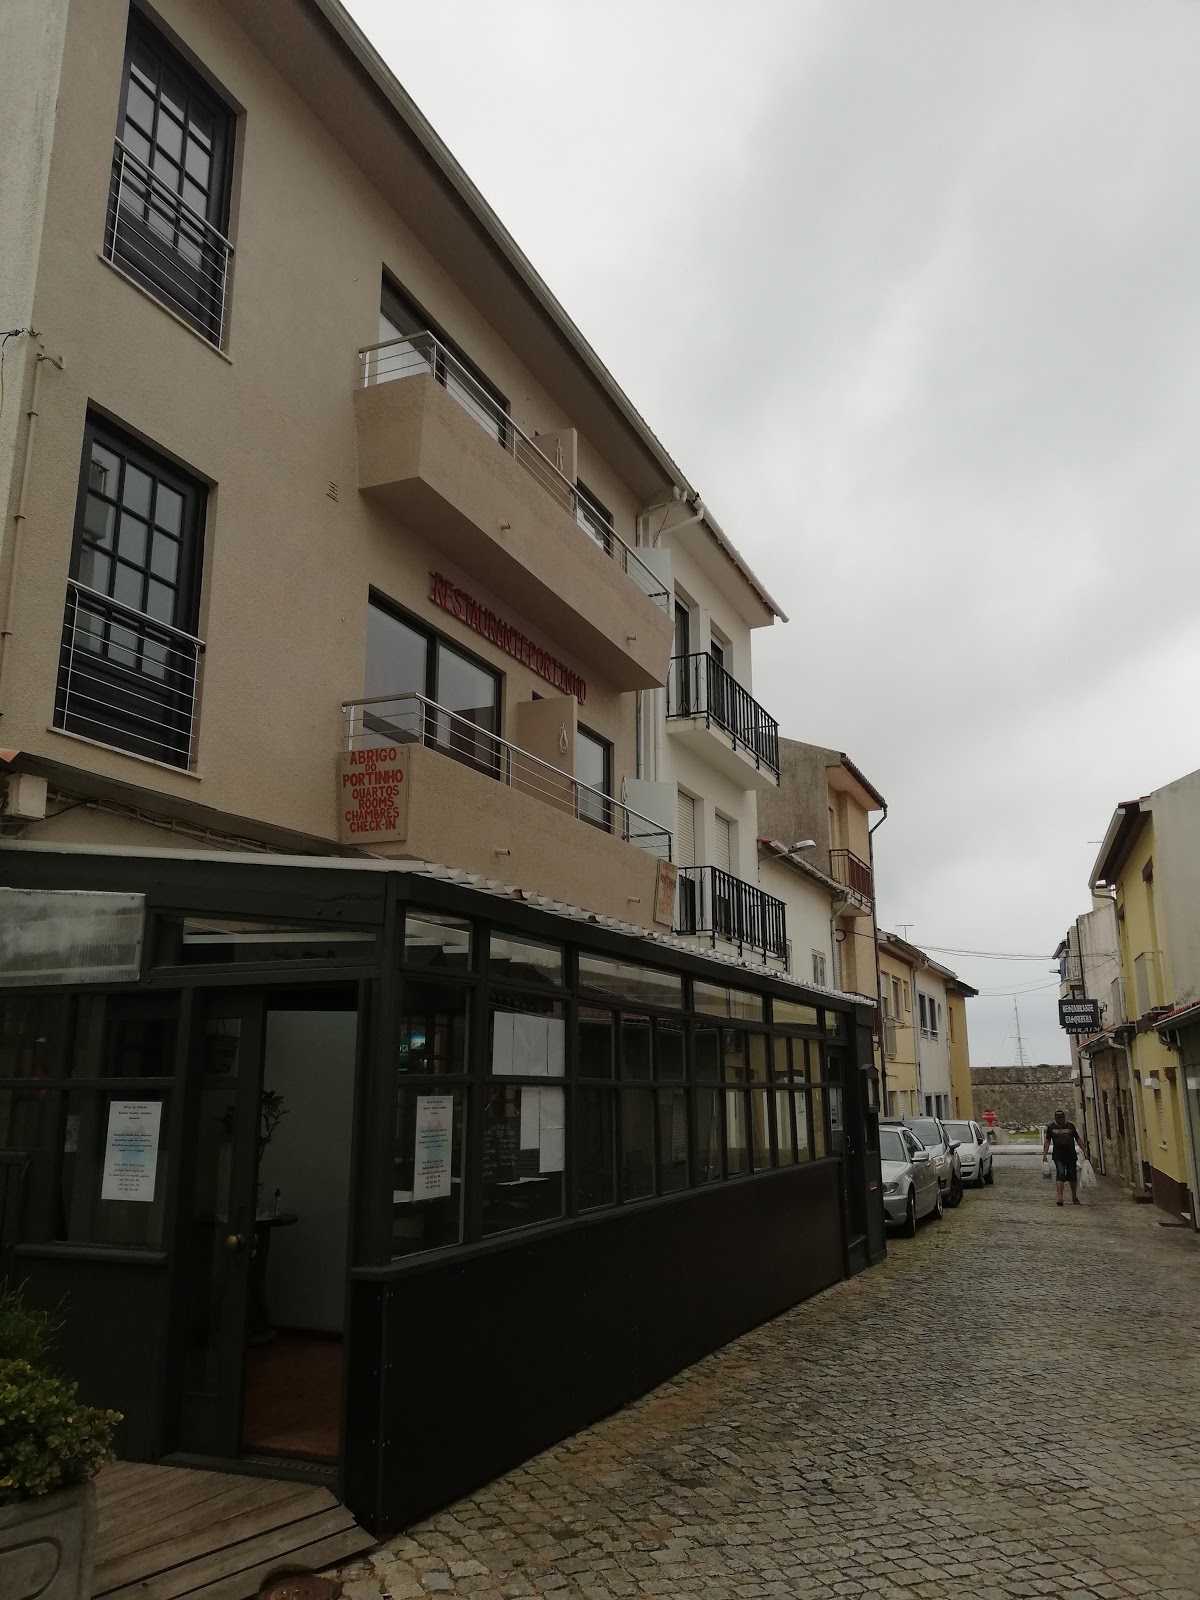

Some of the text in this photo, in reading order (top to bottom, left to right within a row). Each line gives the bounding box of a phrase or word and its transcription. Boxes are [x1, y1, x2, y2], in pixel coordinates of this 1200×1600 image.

[433, 571, 533, 666] RESTAURANTE
[349, 748, 397, 765] ABRIGO
[364, 763, 377, 772] DO
[342, 769, 403, 788] PORTINHO
[352, 785, 399, 800] QUARTOS
[358, 796, 394, 811] ROOMS
[345, 807, 399, 822] CHAMBRES
[349, 819, 396, 833] CHECK-IN
